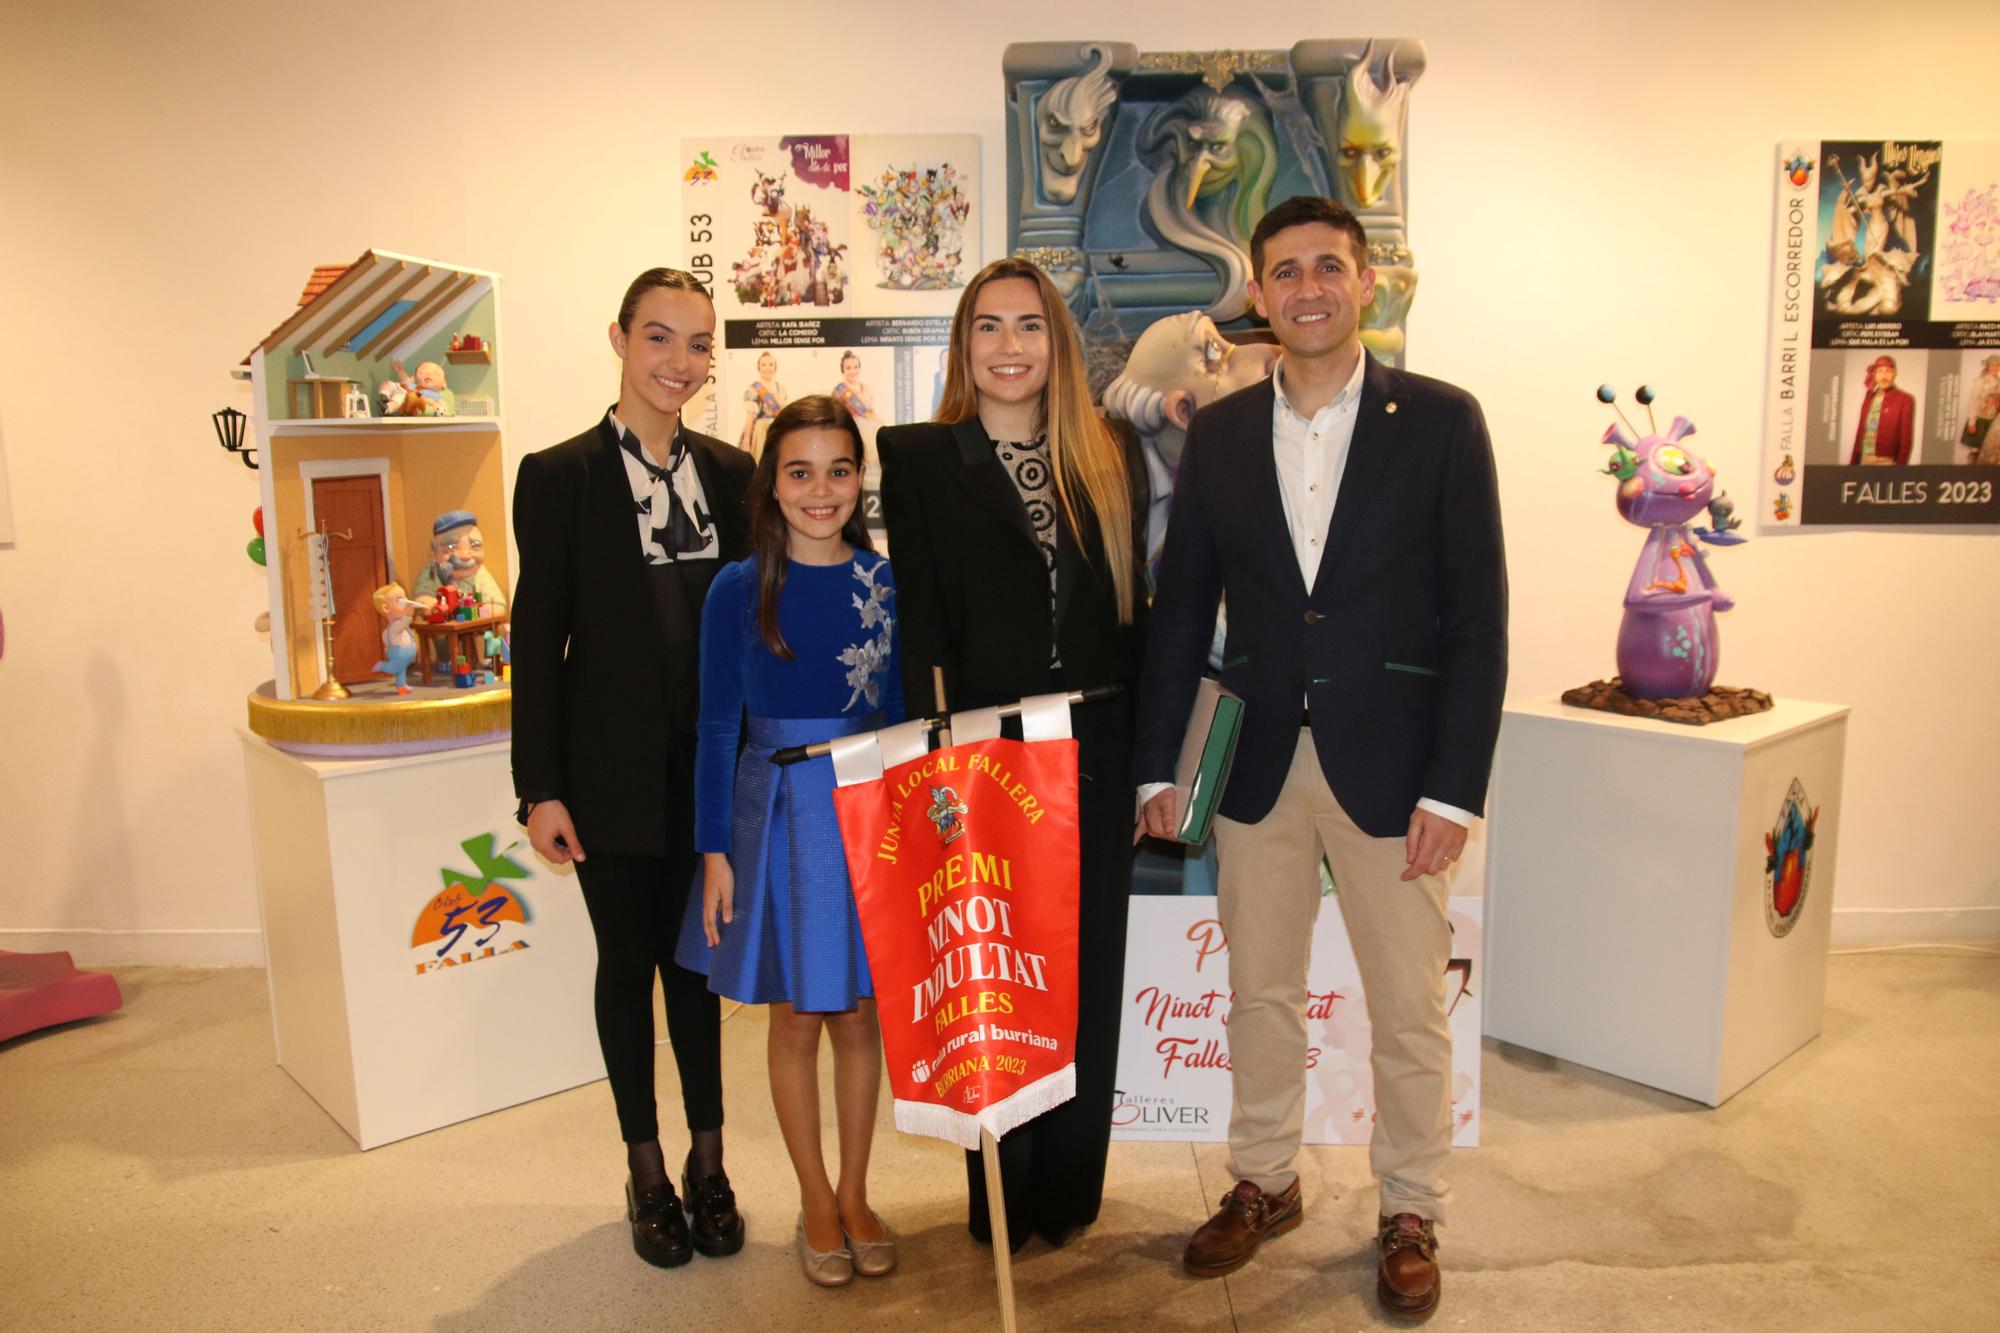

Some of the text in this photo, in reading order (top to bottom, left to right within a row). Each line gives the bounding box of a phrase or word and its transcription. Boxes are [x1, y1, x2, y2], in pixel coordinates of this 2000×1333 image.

[690, 213, 713, 243] 53
[1784, 198, 1805, 322] ESCORREDOR
[1780, 347, 1797, 400] BARRI
[1780, 406, 1795, 451] FALLA
[1842, 481, 1992, 504] FALLES 2023
[897, 756, 961, 799] LOCAL
[968, 753, 1045, 825] FALLERA
[917, 851, 1012, 918] PREMI
[436, 896, 508, 957] 53
[927, 895, 1013, 963] NINOT
[416, 940, 530, 975] FALLA
[912, 942, 1049, 1024] INDULTAT
[935, 991, 1014, 1036] FALLES
[1135, 986, 1226, 1032] Ninot
[947, 1024, 986, 1054] rural
[991, 1024, 1058, 1051] burriana
[934, 1055, 991, 1098] BURRIANA
[995, 1054, 1027, 1076] 2023
[1111, 1104, 1208, 1125] OLIVER
